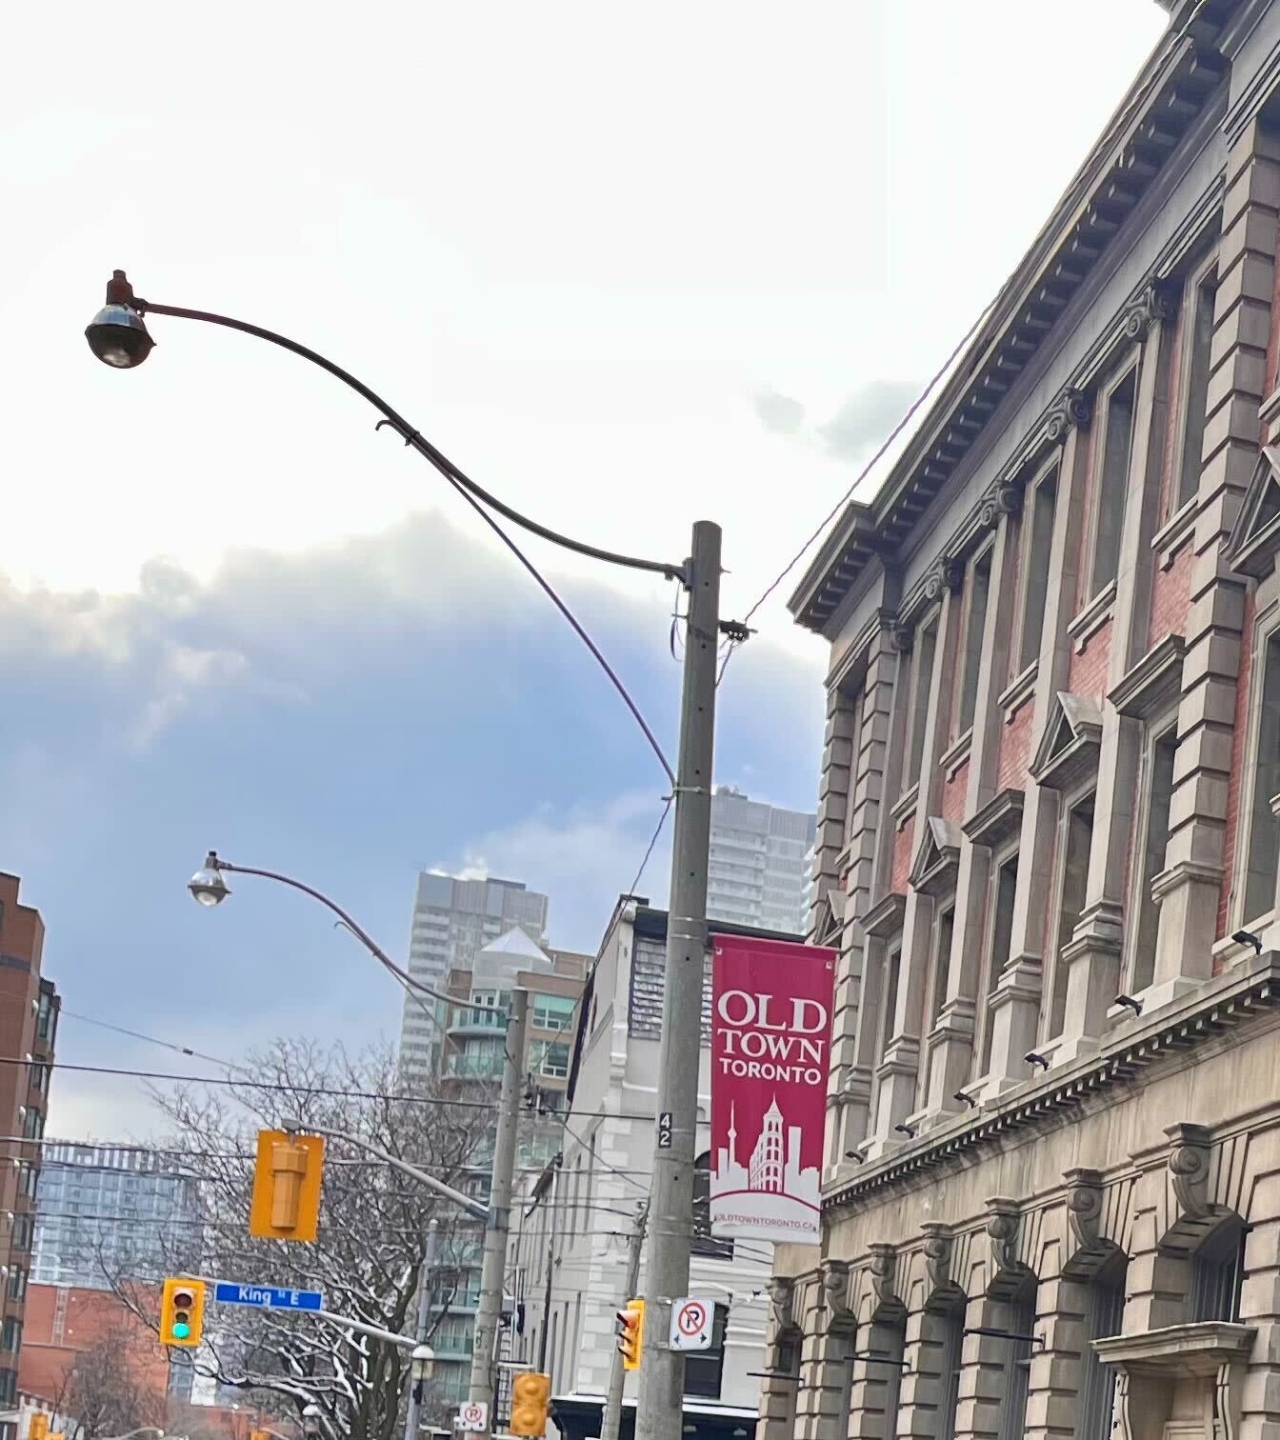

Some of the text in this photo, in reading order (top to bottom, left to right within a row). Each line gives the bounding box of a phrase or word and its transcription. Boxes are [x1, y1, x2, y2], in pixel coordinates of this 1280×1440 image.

[717, 989, 828, 1034] OLD
[717, 1027, 826, 1065] TOWN
[719, 1057, 822, 1085] TORONTO
[238, 1286, 272, 1306] King
[290, 1292, 300, 1305] E
